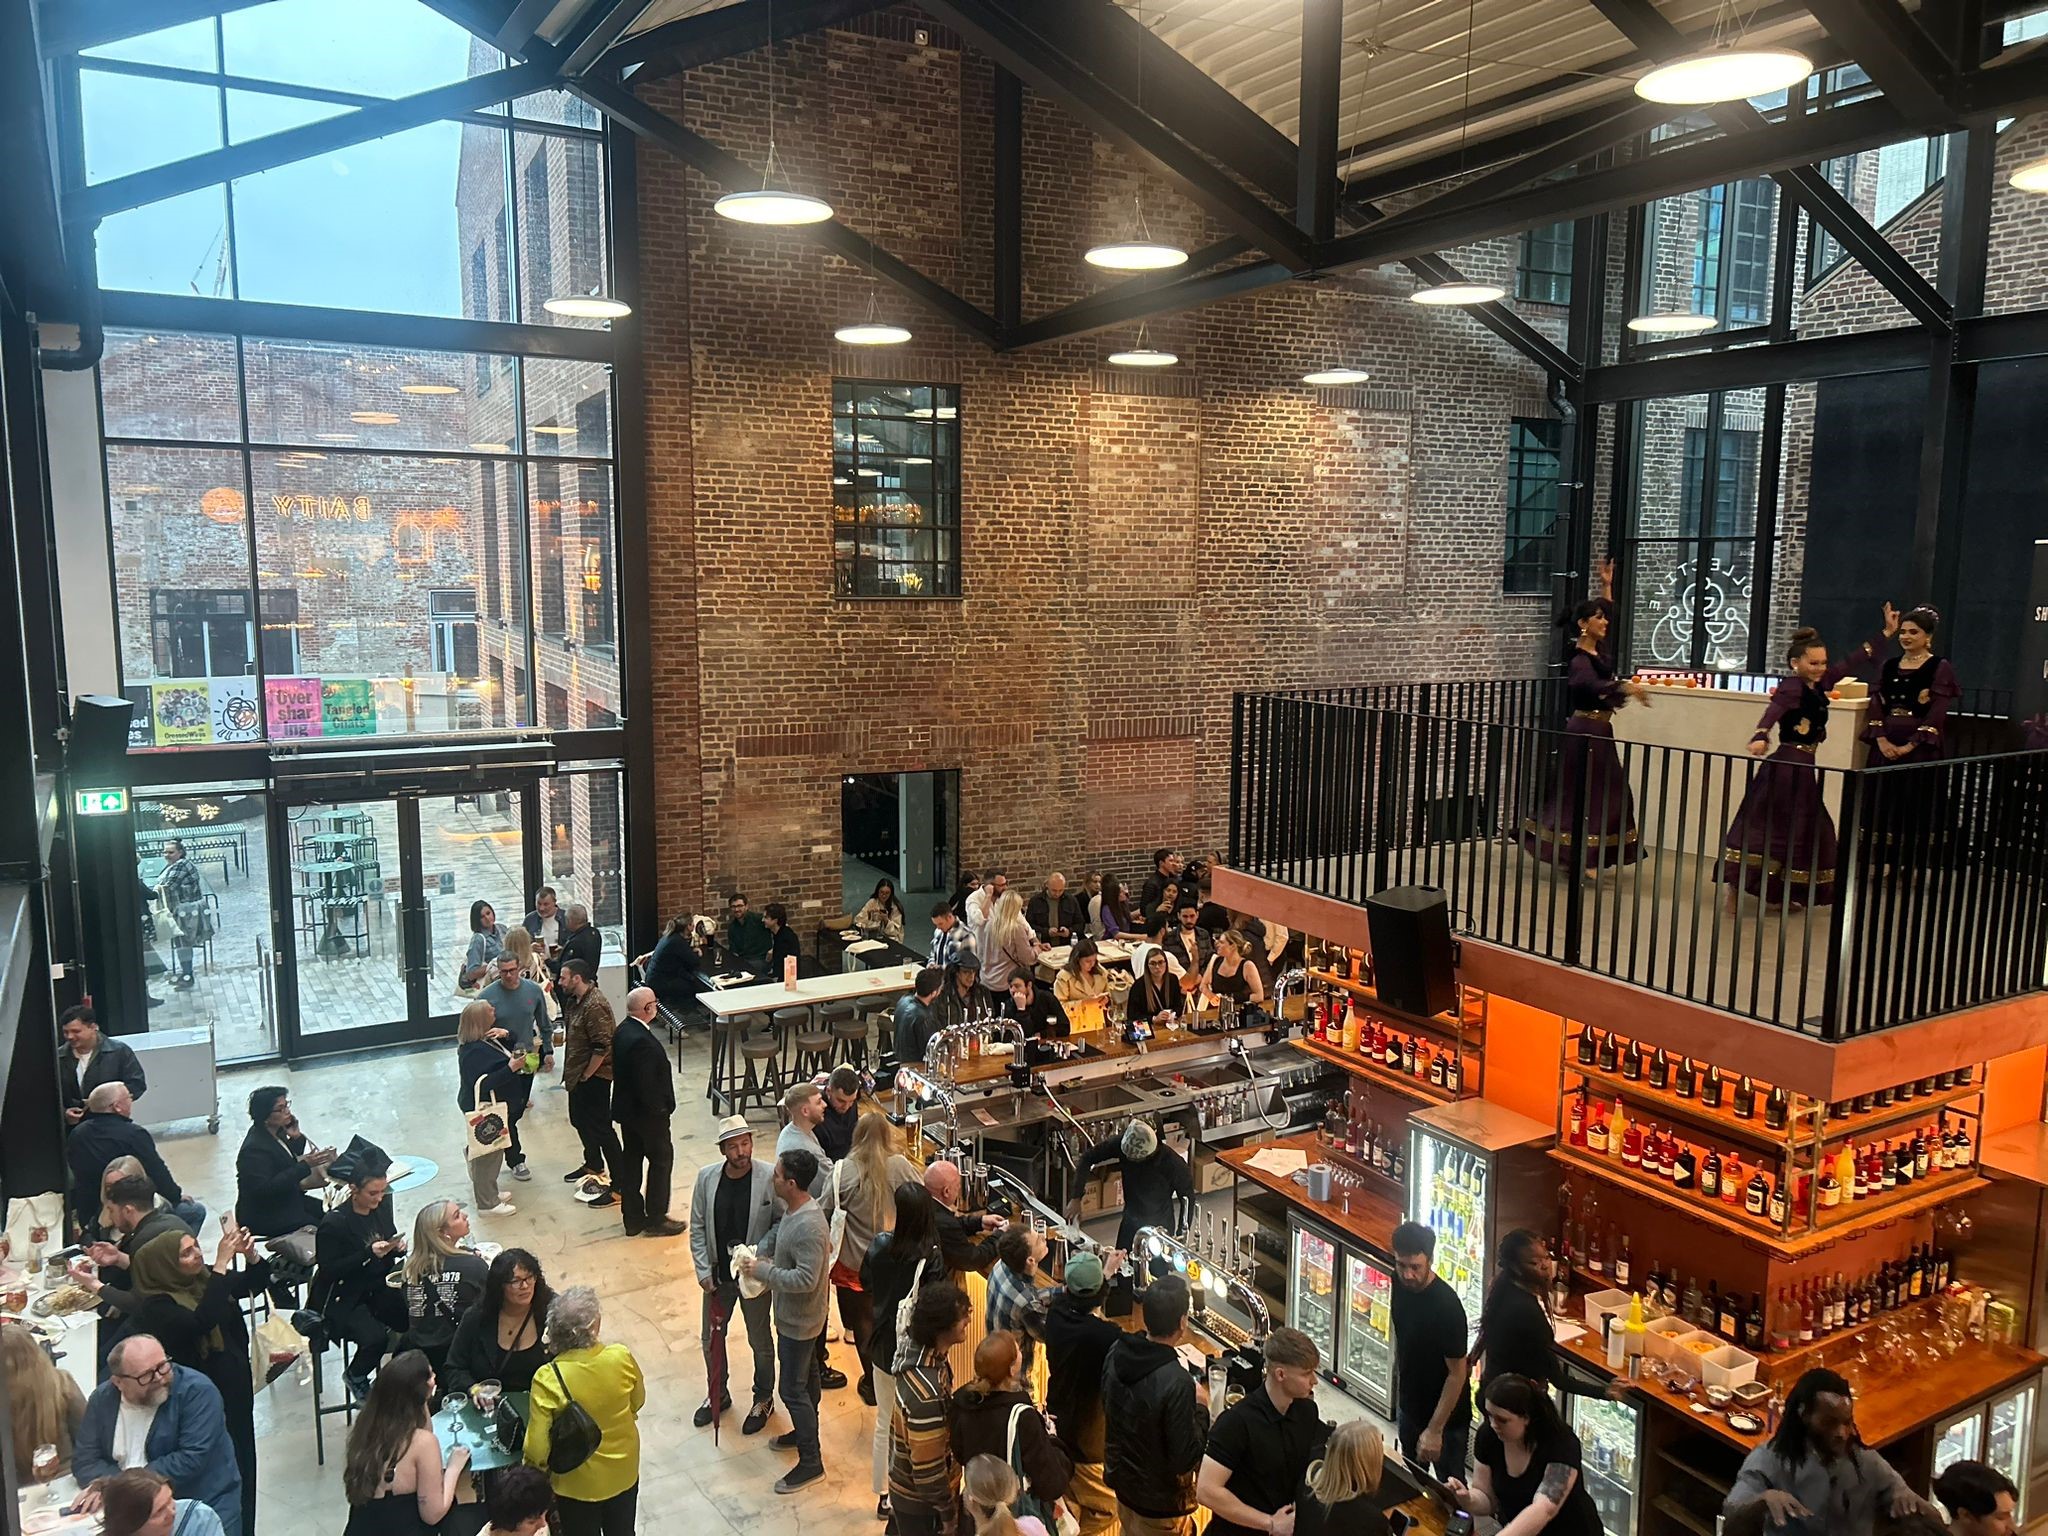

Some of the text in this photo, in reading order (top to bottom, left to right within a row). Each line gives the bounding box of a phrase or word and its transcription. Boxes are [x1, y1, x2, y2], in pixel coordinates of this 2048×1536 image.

[277, 690, 313, 704] Over
[278, 705, 314, 720] shar
[324, 703, 370, 716] Tangled
[284, 721, 308, 737] ing
[332, 717, 366, 729] Chats
[442, 1271, 460, 1282] 1978
